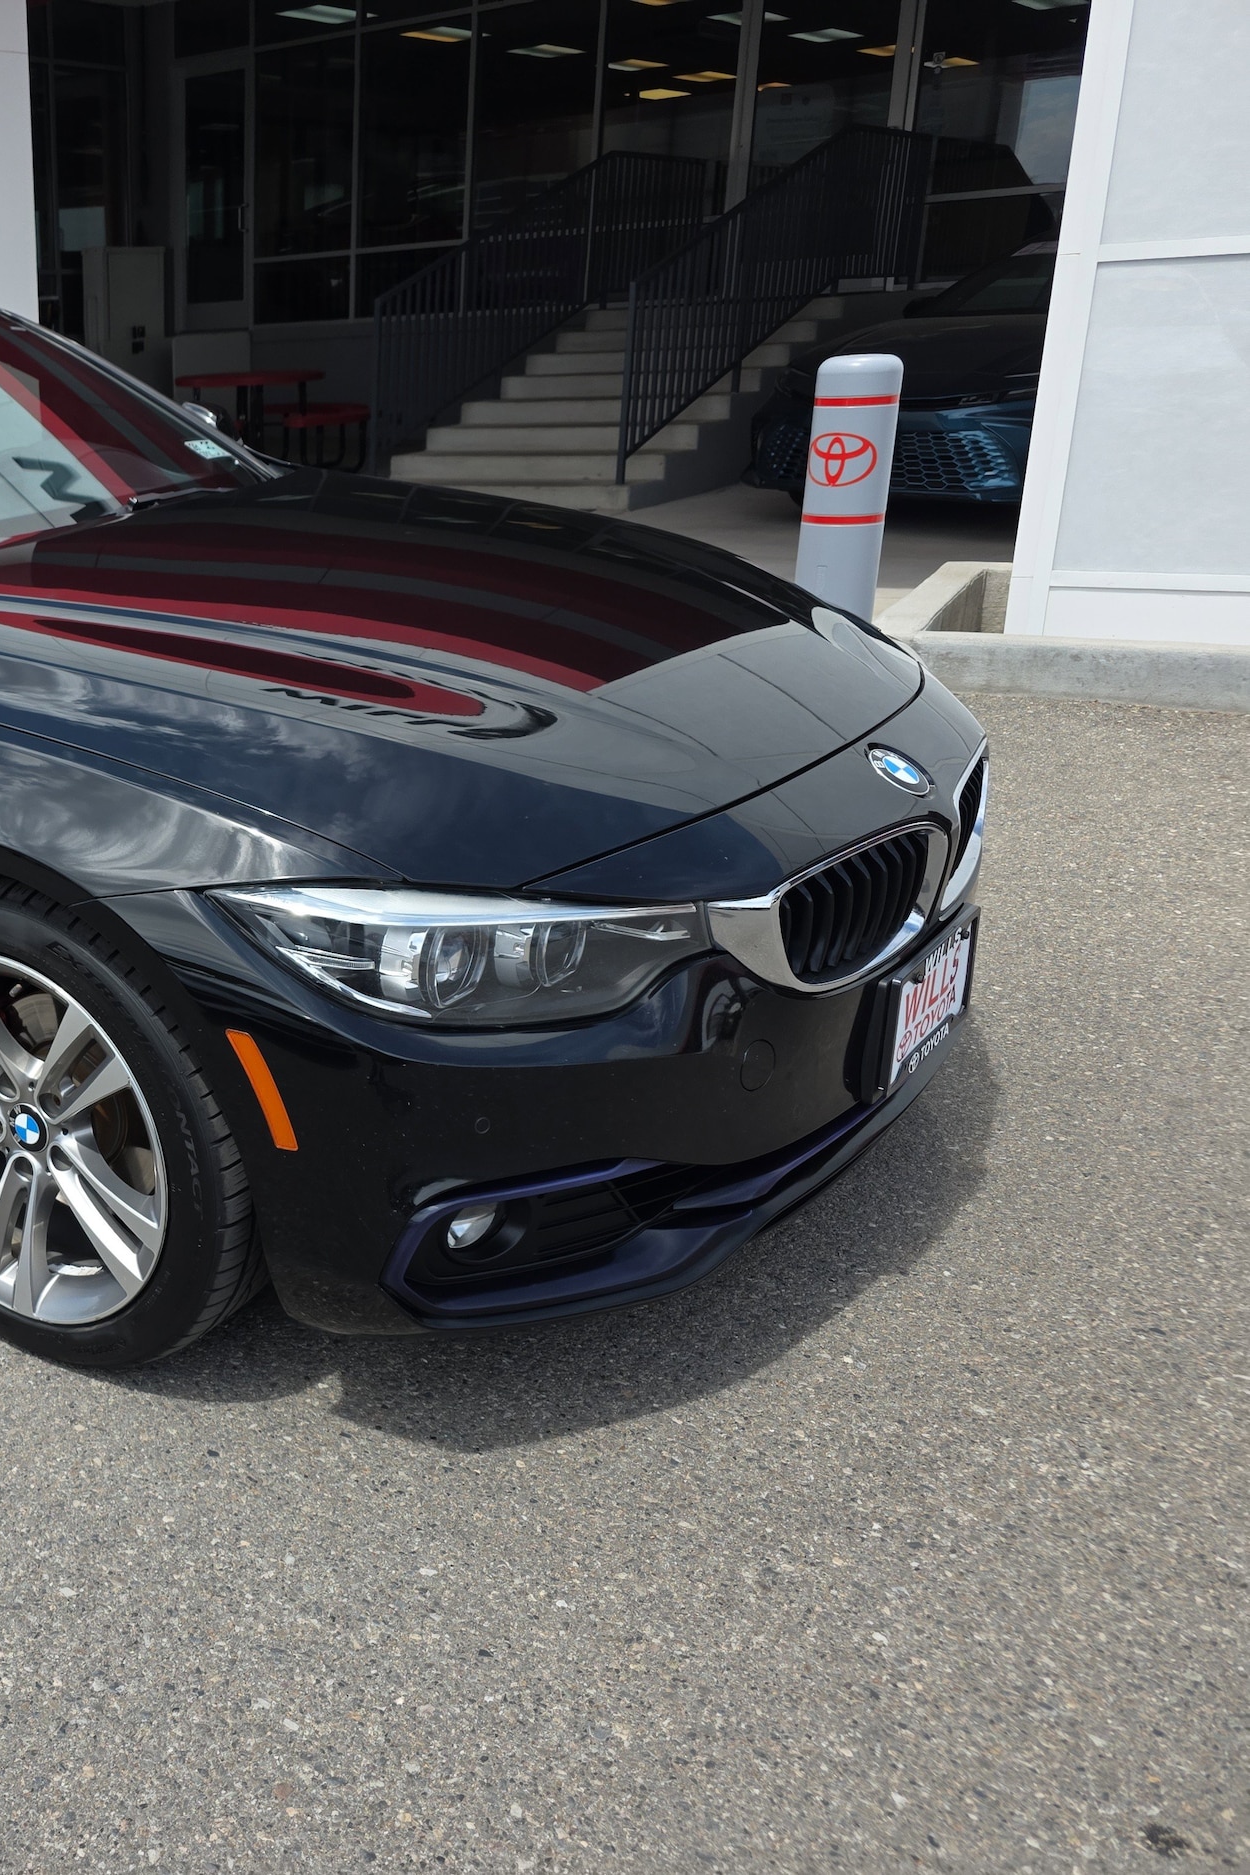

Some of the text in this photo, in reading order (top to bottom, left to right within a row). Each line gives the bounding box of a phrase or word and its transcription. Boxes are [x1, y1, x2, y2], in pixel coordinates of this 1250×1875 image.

[924, 927, 962, 974] WILLS
[905, 944, 961, 1030] WILLS
[912, 986, 956, 1043] TOYOTA
[920, 1022, 950, 1061] TOYOTA
